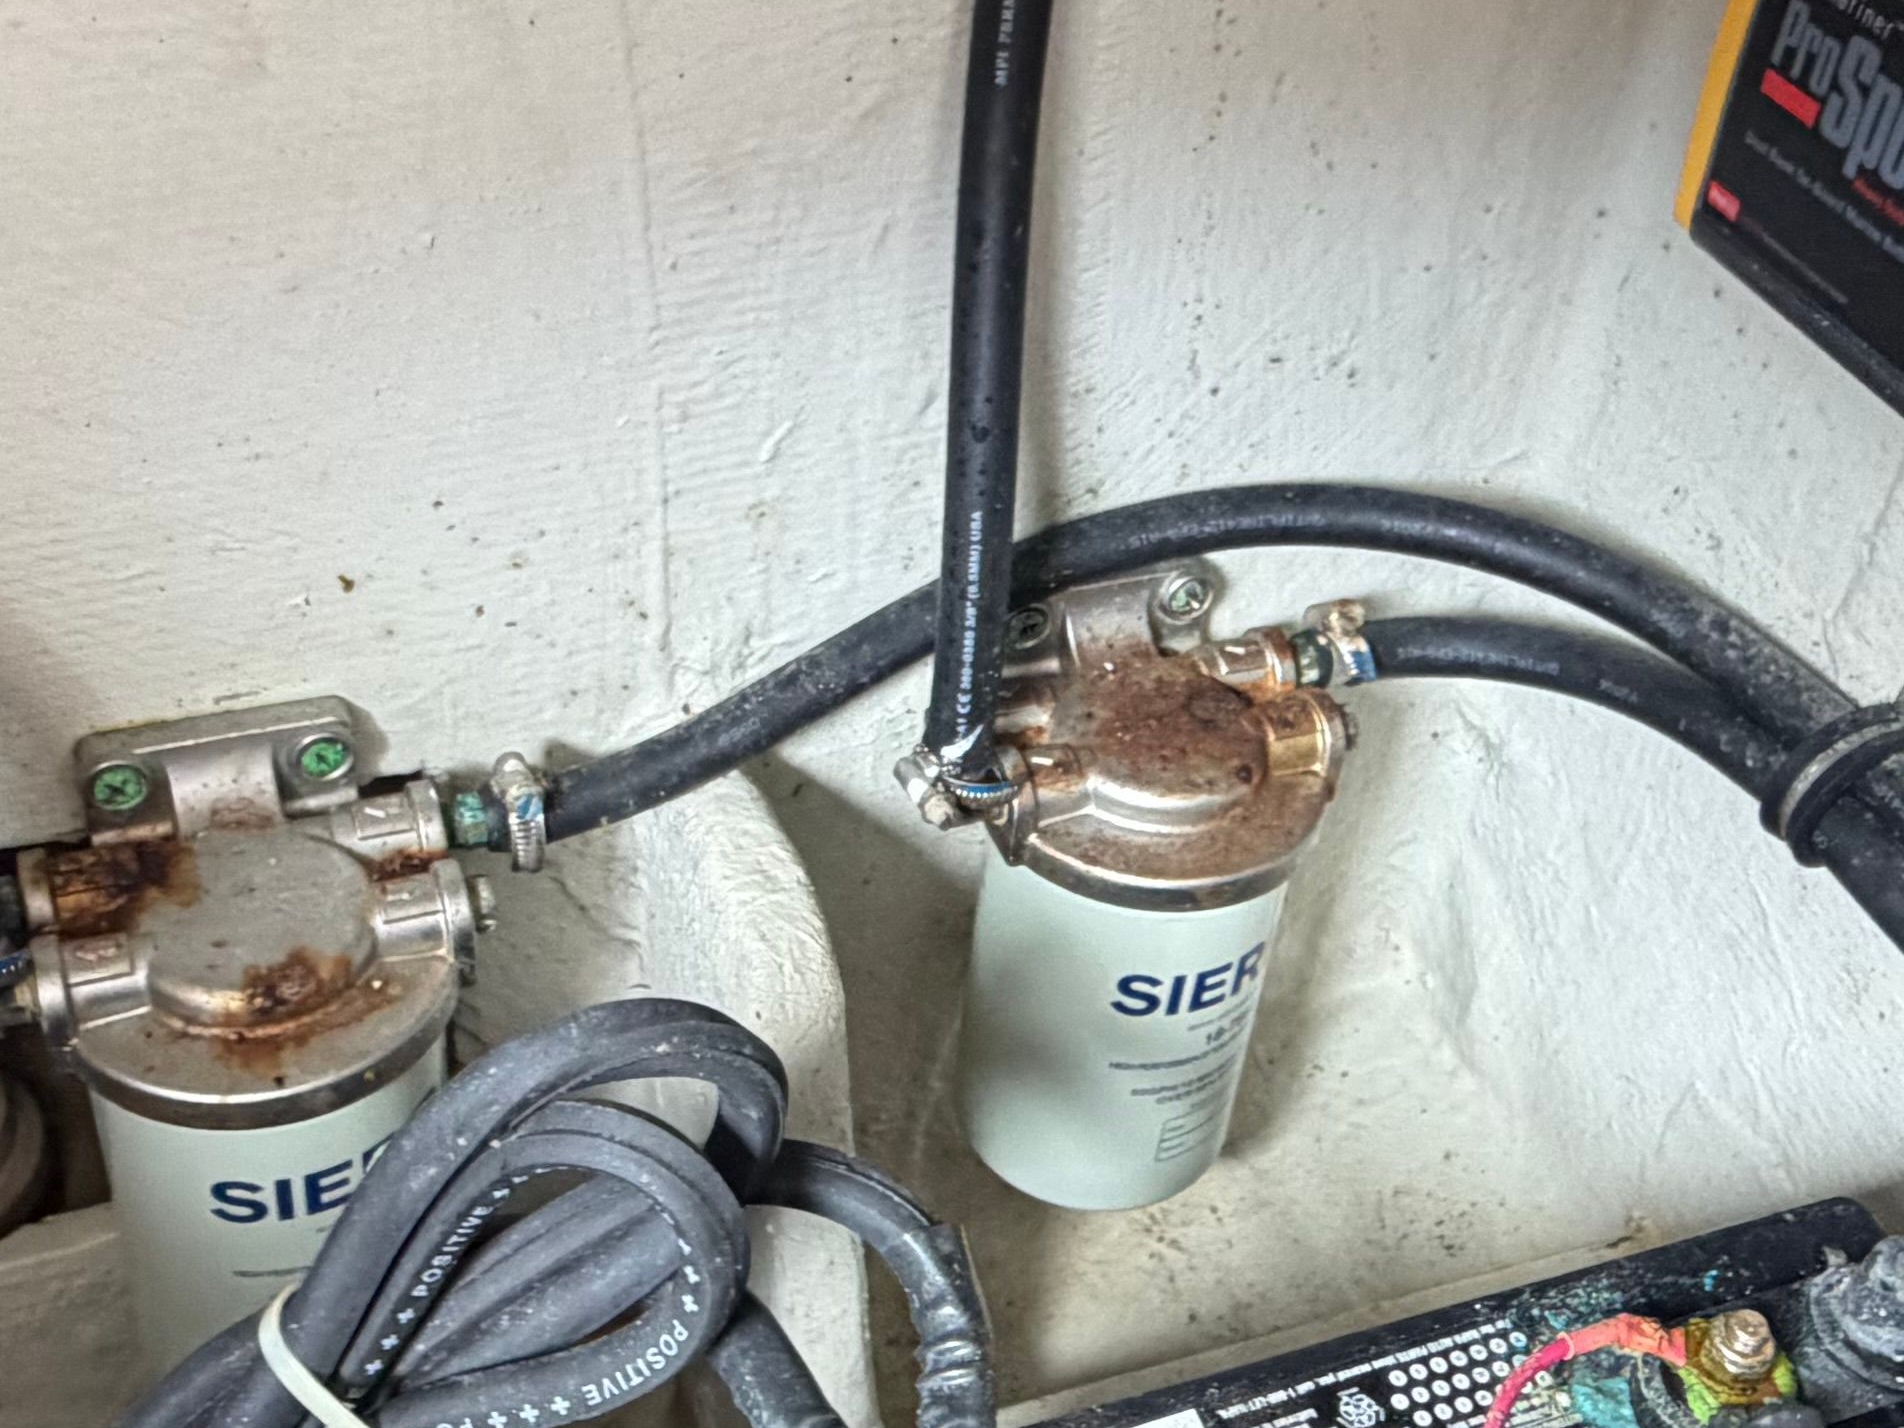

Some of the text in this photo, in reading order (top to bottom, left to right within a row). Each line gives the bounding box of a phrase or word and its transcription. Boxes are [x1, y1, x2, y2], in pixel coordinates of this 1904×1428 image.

[970, 510, 983, 542] USA
[1110, 941, 1267, 1018] SIER
[208, 1141, 394, 1225] SIE
[411, 1204, 494, 1298] POSITIVE
[585, 1318, 689, 1407] POSITIVE
